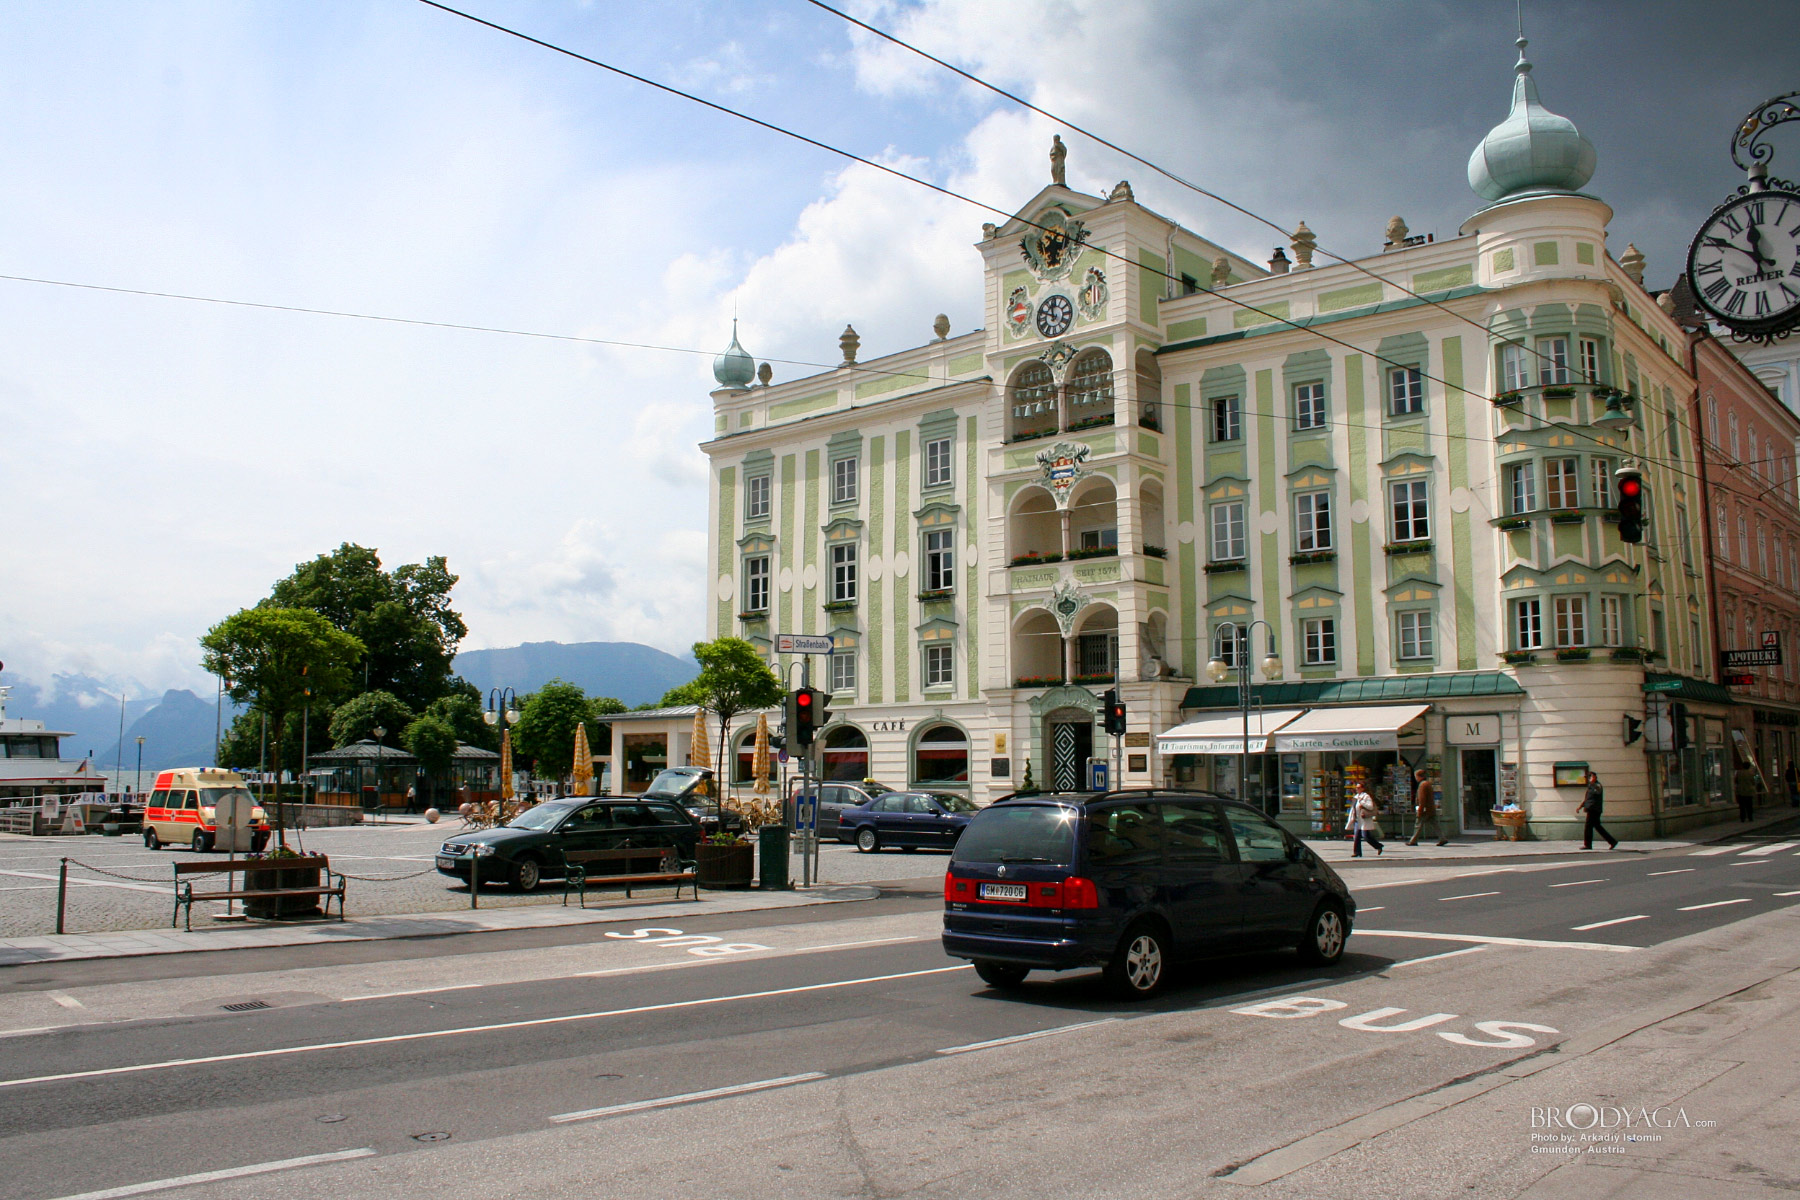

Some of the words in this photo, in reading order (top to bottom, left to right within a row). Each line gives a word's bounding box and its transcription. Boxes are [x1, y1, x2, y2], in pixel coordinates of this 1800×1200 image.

[1736, 269, 1784, 286] REITER
[1076, 568, 1096, 577] SEIT
[1098, 566, 1117, 575] 1574
[795, 639, 829, 649] Straßenbahn
[1728, 650, 1778, 662] APOTHEKE
[873, 717, 906, 731] CAFÉ
[1466, 722, 1481, 736] M
[1210, 742, 1254, 750] Informatn
[1292, 738, 1323, 748] Karten
[1332, 737, 1380, 747] Geschenke
[604, 928, 776, 956] BUS
[1228, 997, 1559, 1048] BUS
